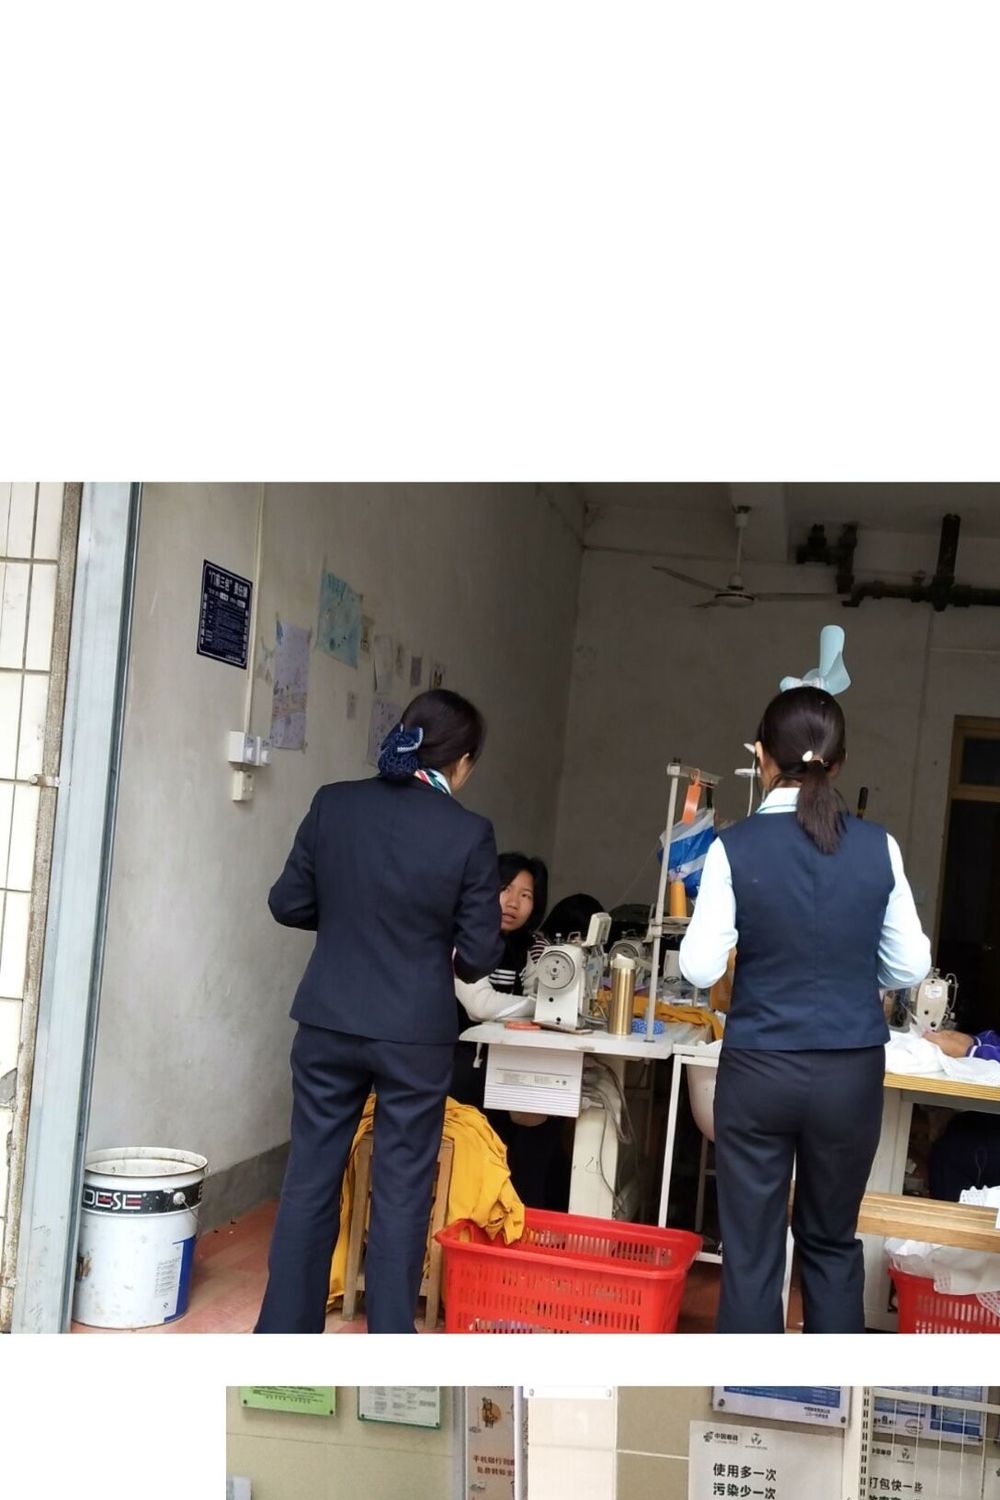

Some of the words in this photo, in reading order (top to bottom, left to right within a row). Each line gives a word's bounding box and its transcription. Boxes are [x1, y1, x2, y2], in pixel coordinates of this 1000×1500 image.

[713, 1463, 777, 1482] 使用多一次
[713, 1482, 777, 1500] 污染少一次
